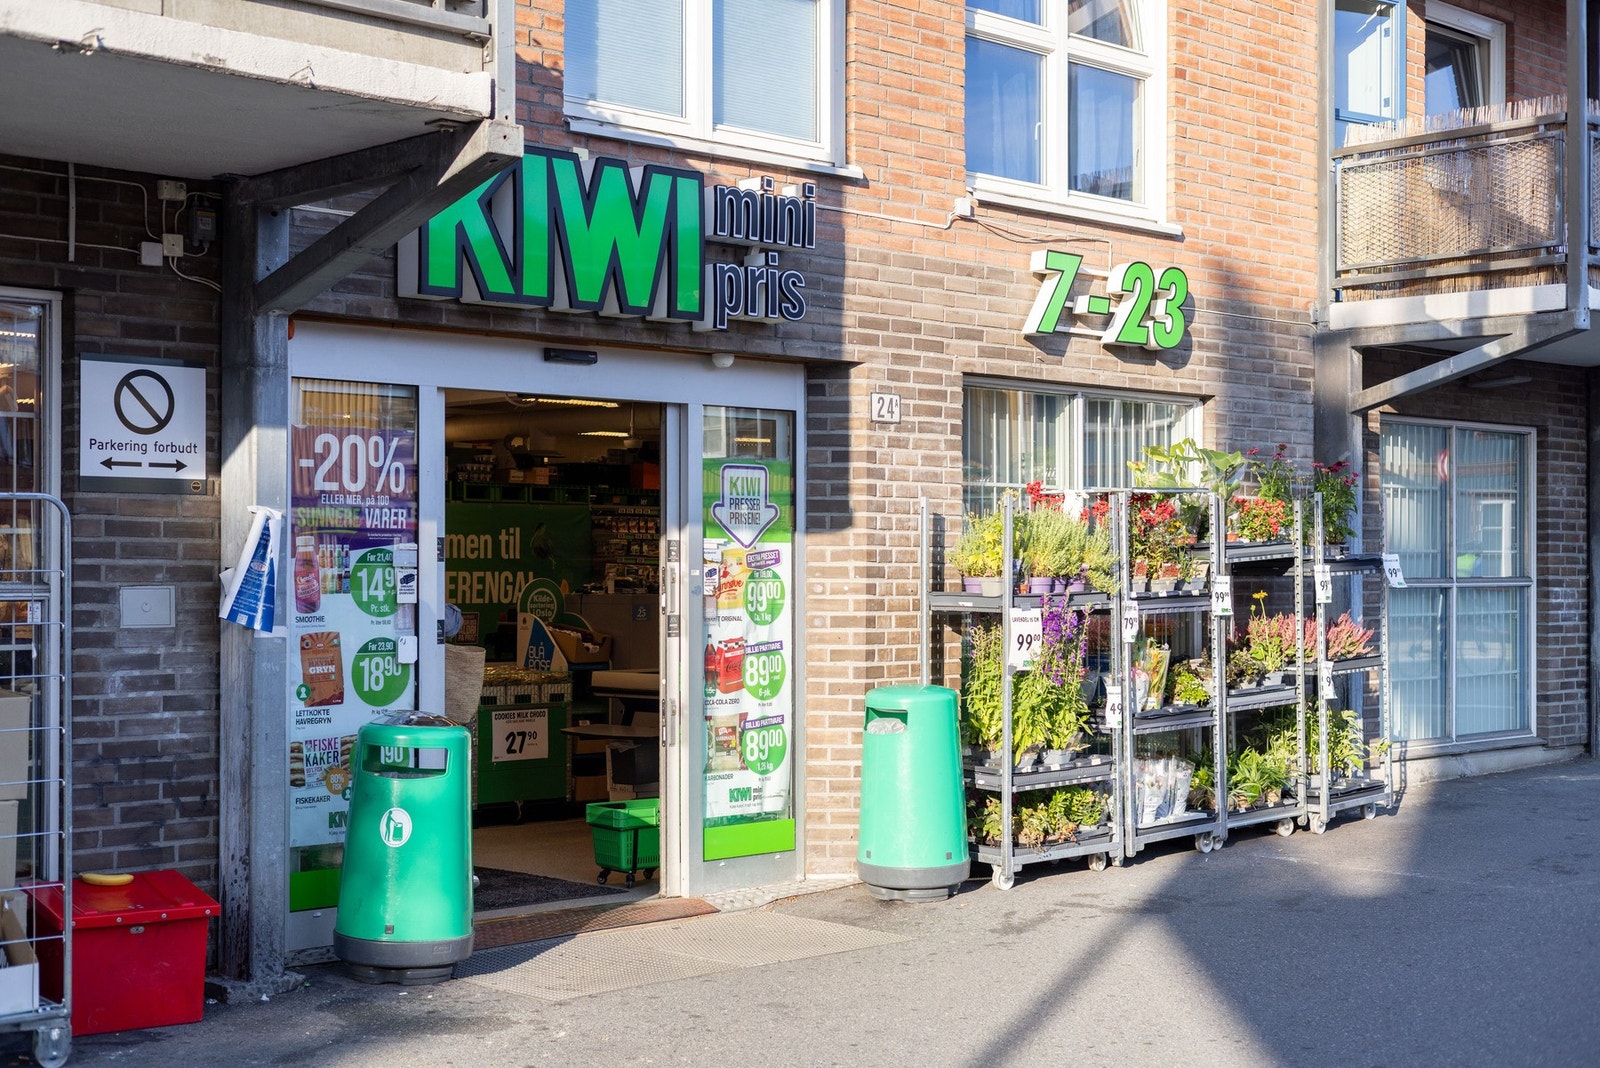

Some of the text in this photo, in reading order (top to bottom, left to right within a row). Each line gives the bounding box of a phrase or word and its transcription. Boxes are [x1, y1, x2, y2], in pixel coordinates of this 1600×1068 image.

[713, 176, 816, 249] mini
[418, 146, 704, 321] KIWI
[713, 251, 807, 330] pris
[1036, 250, 1189, 349] 7-23
[89, 438, 198, 455] Parkering forbudt
[300, 433, 405, 494] -20%
[729, 476, 761, 496] KIWI
[321, 494, 345, 504] ELLER
[366, 496, 375, 506] på
[377, 495, 390, 505] 100
[729, 497, 761, 511] PRESSER
[297, 507, 407, 529] SUNNERE VARER
[499, 527, 521, 560] til
[295, 616, 326, 624] SMOOTHIE
[529, 641, 546, 659] BLÅ
[308, 666, 336, 674] GRYN
[295, 709, 330, 717] LETTKOKTE
[295, 717, 332, 725] HAVREGRYN
[494, 712, 516, 721] COOKIES
[313, 737, 339, 752] FISKE
[305, 751, 339, 767] KAKER
[295, 795, 331, 805] FISKEKAKER
[729, 787, 752, 803] KIWI
